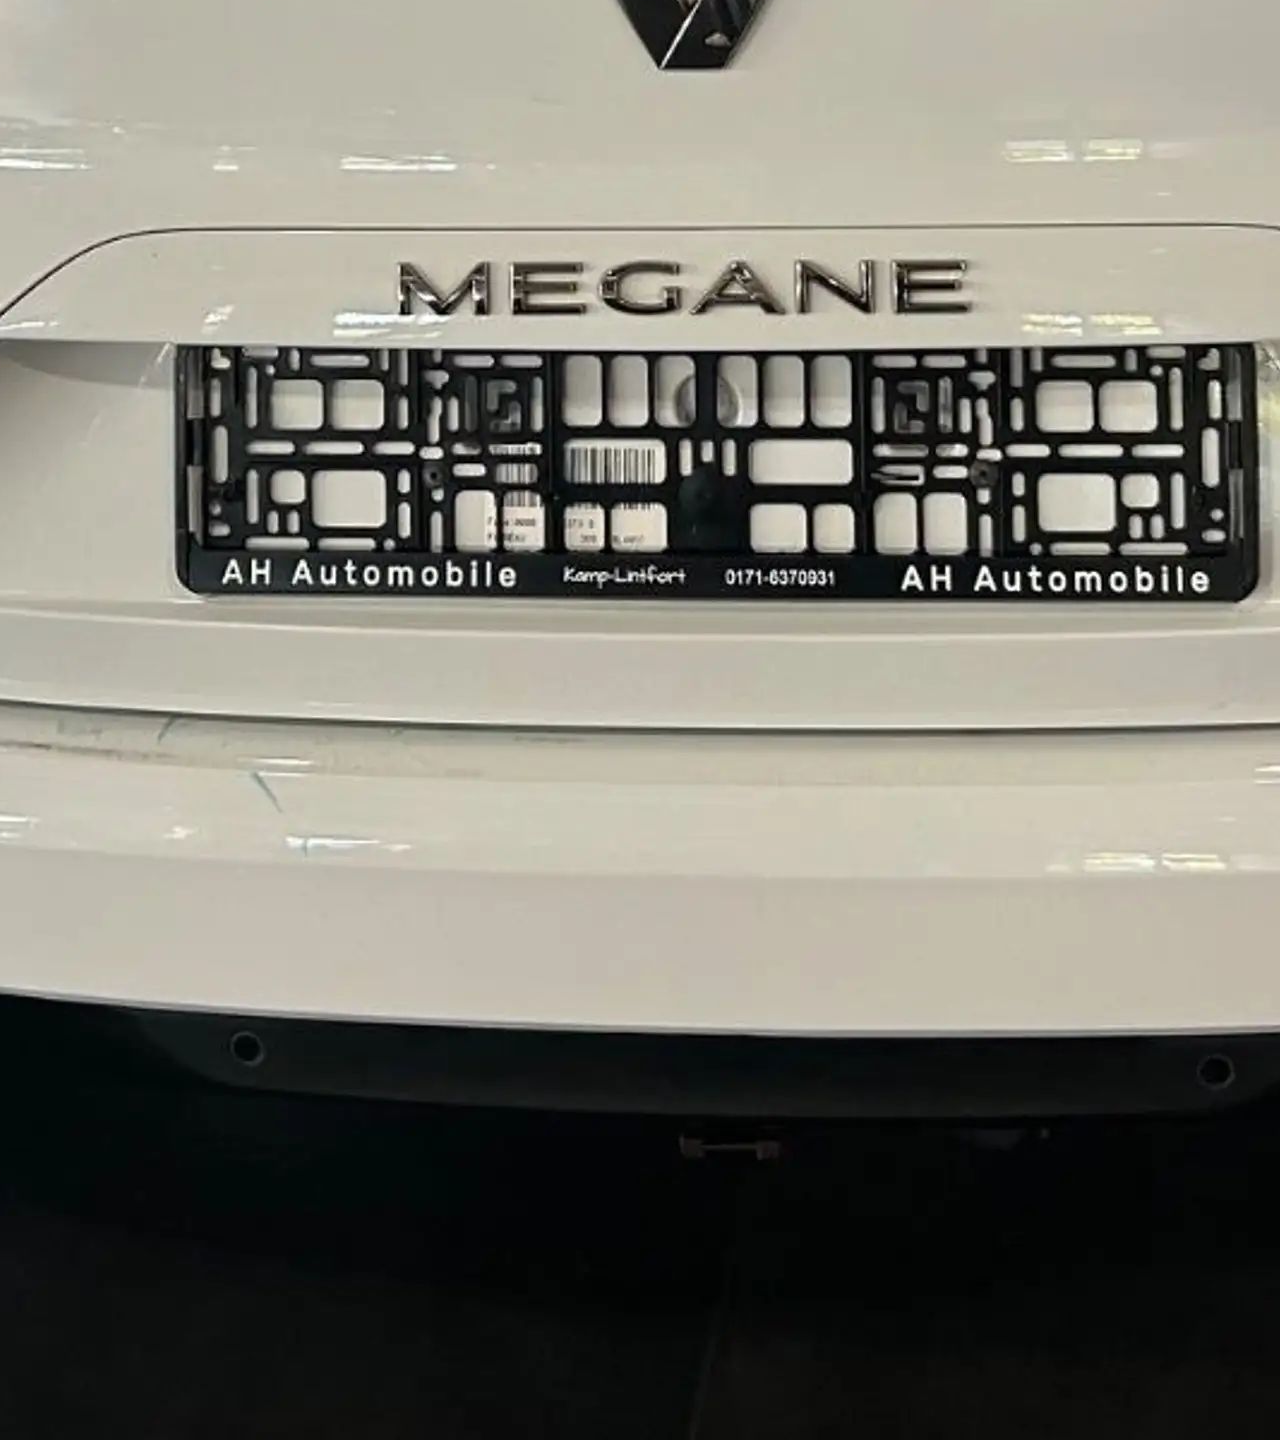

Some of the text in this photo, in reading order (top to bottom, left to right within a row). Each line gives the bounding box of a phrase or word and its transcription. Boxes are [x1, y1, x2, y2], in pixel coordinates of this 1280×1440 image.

[397, 261, 970, 315] MEGANE
[222, 559, 518, 587] AH Automobile
[564, 565, 686, 589] Kamp-Lintfort
[726, 569, 836, 586] 0171-6370931
[901, 565, 1211, 593] AH Automobile
